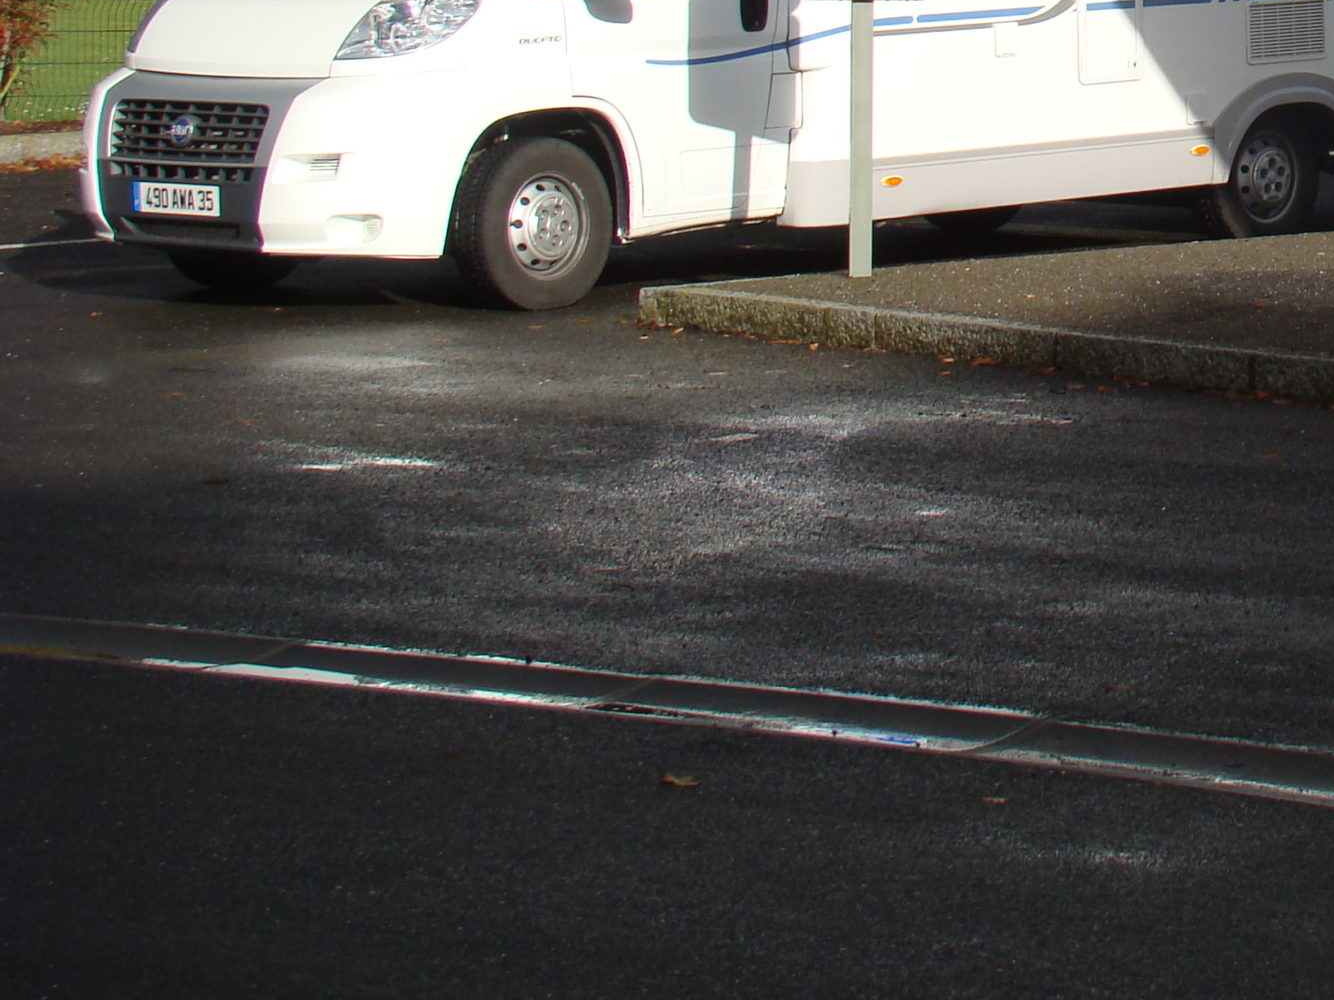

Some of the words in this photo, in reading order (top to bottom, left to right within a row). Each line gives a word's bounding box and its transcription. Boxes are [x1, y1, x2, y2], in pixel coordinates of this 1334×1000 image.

[145, 187, 169, 208] 490
[172, 188, 195, 210] AWA
[197, 190, 214, 211] 35
